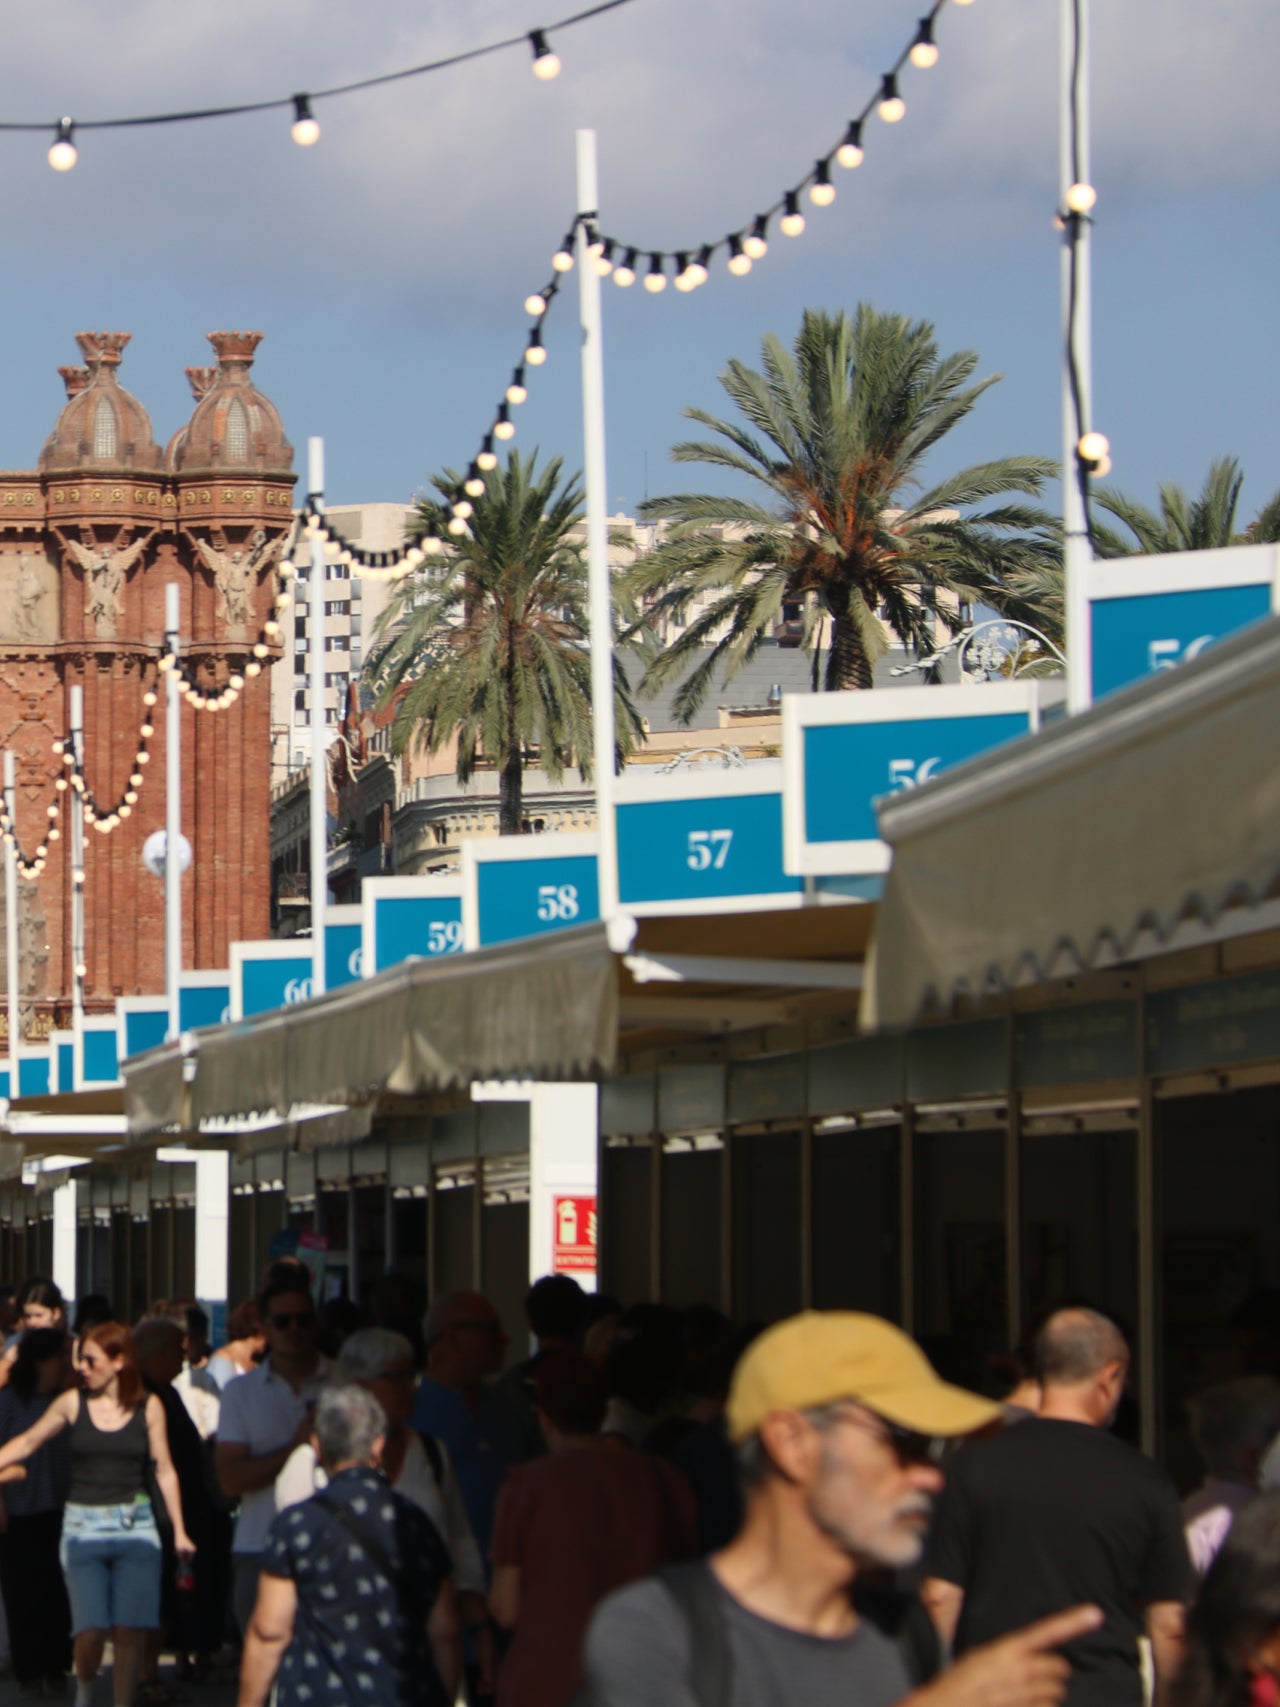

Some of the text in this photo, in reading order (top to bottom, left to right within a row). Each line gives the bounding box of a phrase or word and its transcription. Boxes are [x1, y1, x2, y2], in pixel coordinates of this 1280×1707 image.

[888, 757, 941, 797] 56
[687, 829, 733, 870] 57
[537, 884, 579, 921] 58
[427, 920, 464, 953] 59
